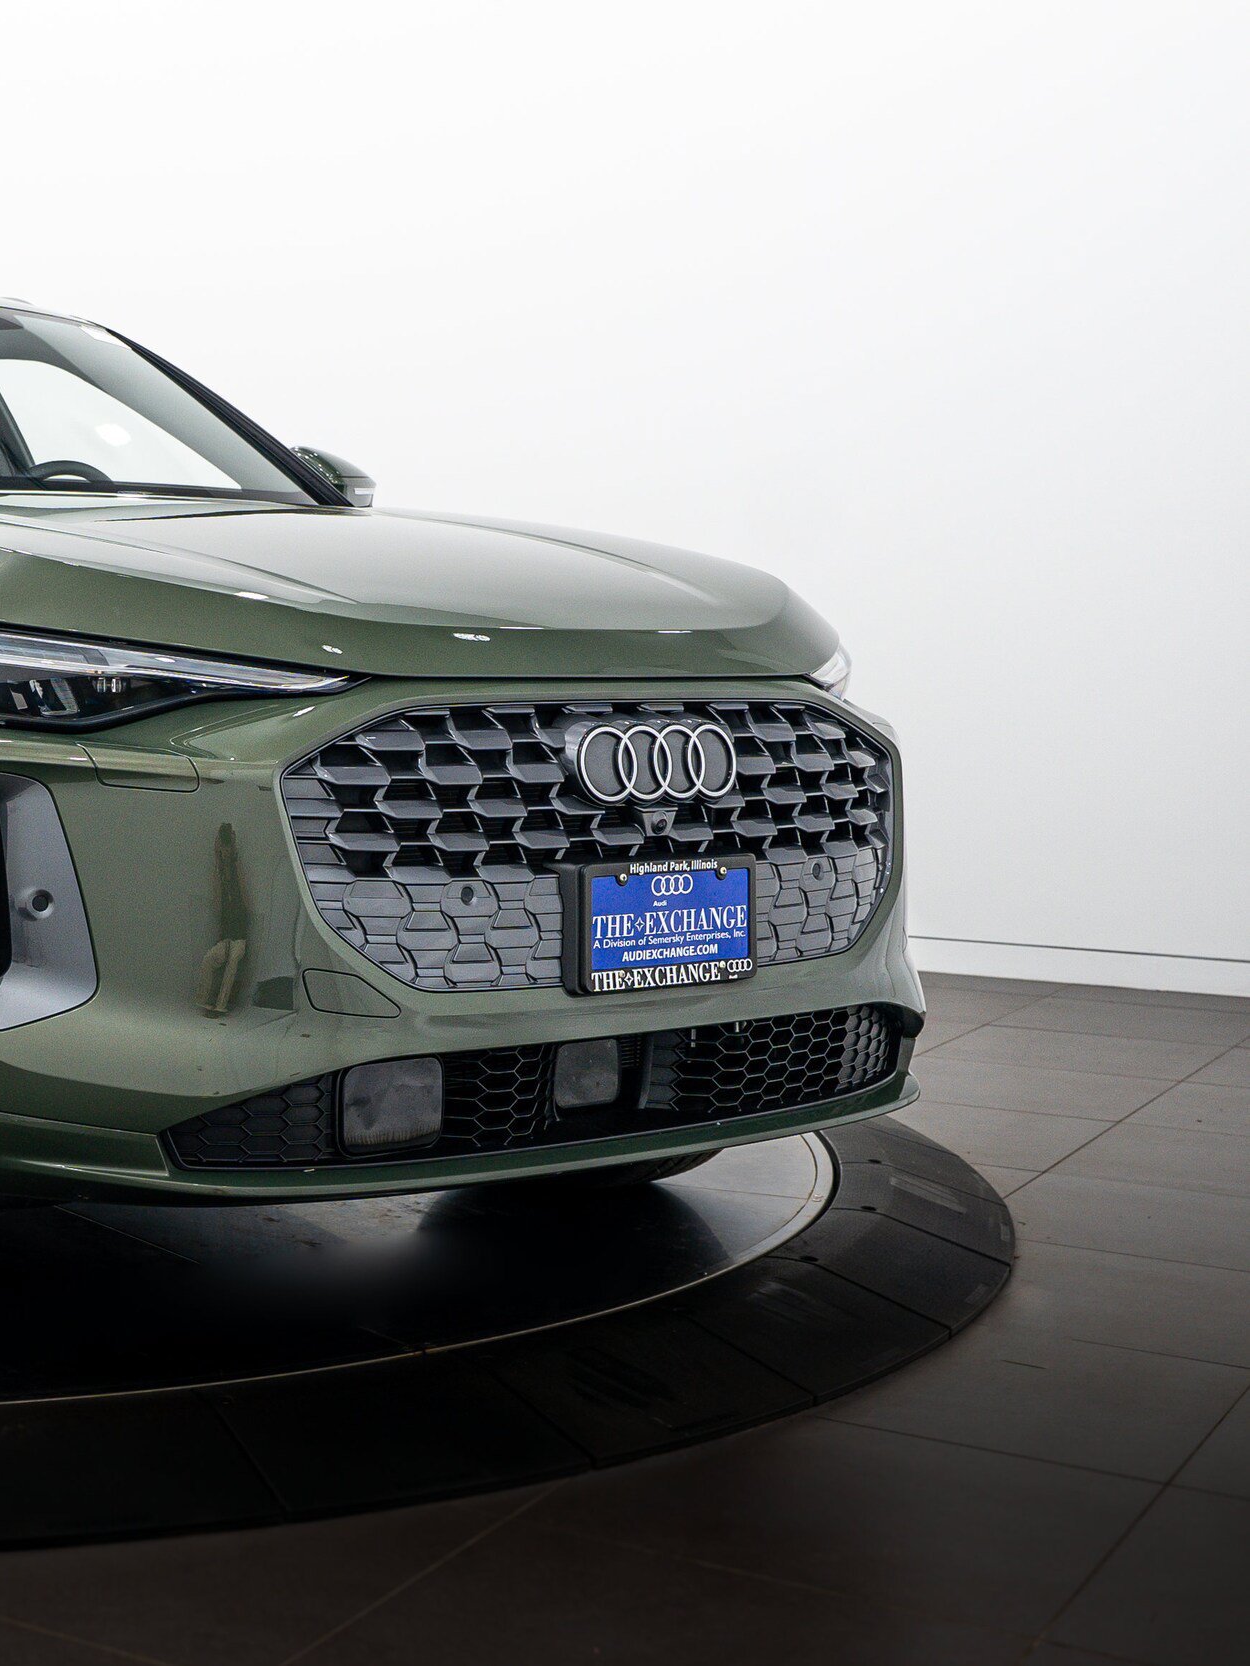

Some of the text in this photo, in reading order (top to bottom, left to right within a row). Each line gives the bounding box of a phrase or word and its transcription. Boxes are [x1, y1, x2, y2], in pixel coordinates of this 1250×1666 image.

[630, 859, 718, 876] Highland Park, Illinois
[592, 904, 747, 939] THE EXCHANGE
[593, 928, 746, 949] A Division of Semersky Enterprises, Inc.
[622, 943, 718, 962] AUDIEXCHANGE.COM
[591, 961, 720, 992] THE EXCHANGE
